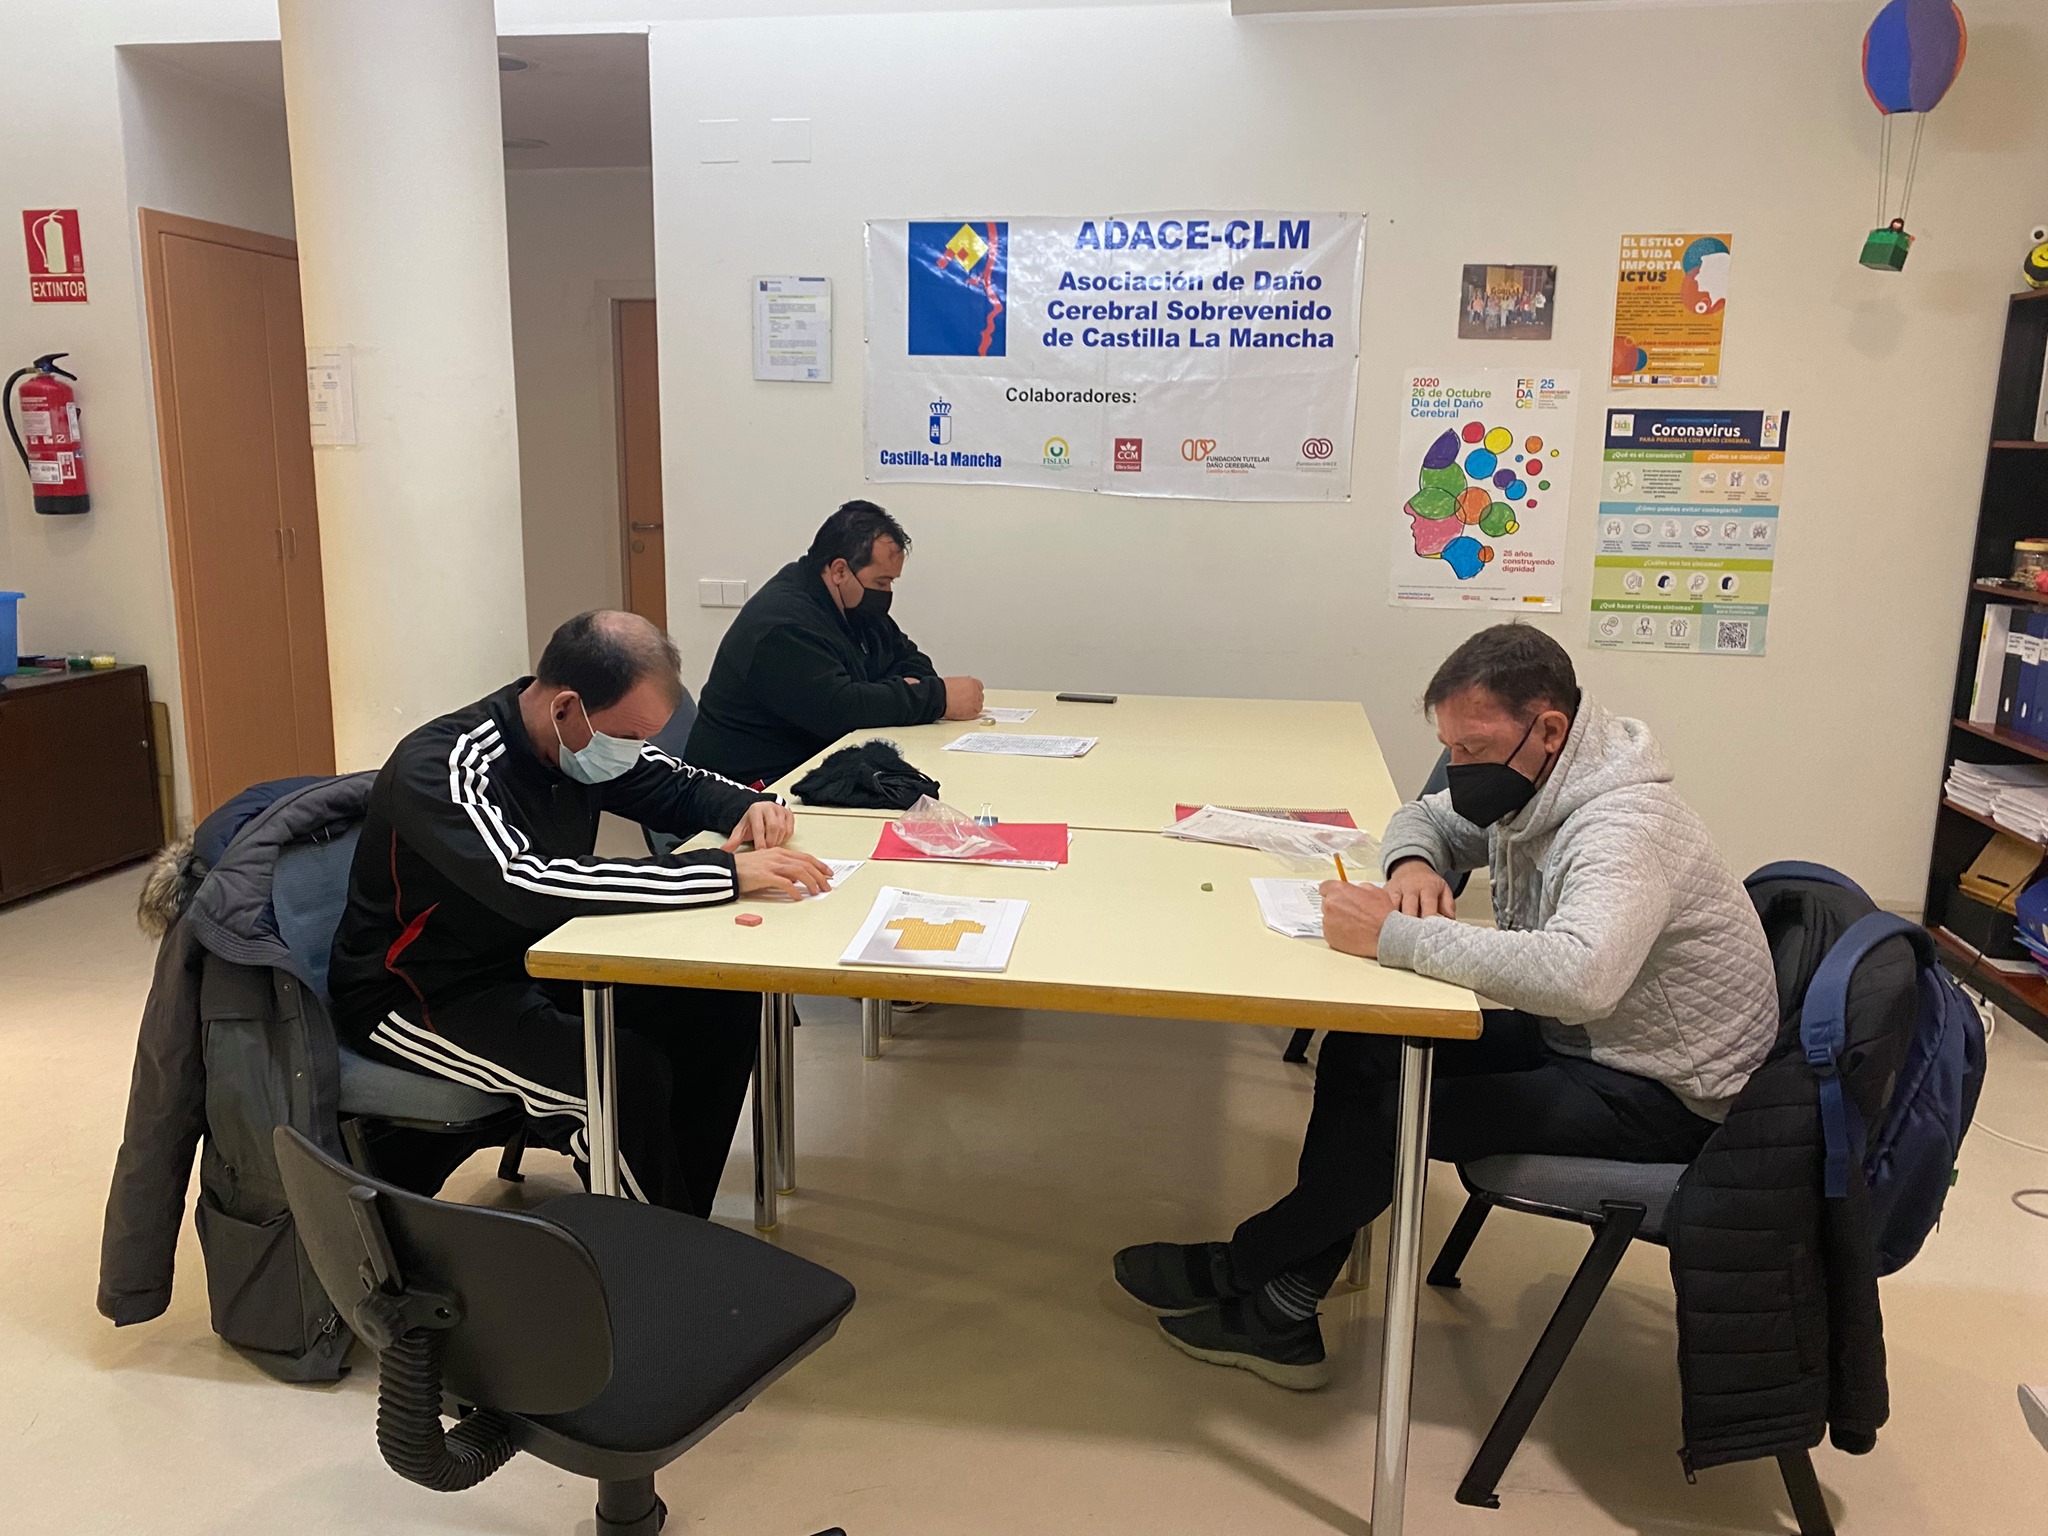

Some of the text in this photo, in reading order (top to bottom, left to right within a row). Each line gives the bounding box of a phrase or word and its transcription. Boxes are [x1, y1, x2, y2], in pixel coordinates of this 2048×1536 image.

[1075, 220, 1311, 250] ADACE-CLM
[1623, 237, 1685, 247] EL ESTILO
[1622, 249, 1672, 259] DE VIDA
[1621, 261, 1682, 270] IMPORTA
[1058, 270, 1322, 291] Asociación de Daño
[1620, 271, 1667, 282] ICTUS
[32, 281, 86, 298] EXTINTOR
[1048, 300, 1332, 321] Cerebral Sobrevenido
[1042, 327, 1334, 348] de Castilla La Mancha
[1412, 378, 1440, 387] 2020
[1540, 379, 1555, 389] 25
[1005, 387, 1137, 404] Colaboradores:
[1412, 388, 1492, 398] 26 de Octubre
[1411, 398, 1484, 409] Día del Daño
[1411, 408, 1459, 418] Cerebral
[1652, 424, 1741, 437] Coronavirus
[880, 450, 1002, 468] Castilla-La Mancha
[1117, 451, 1138, 460] CCM
[1612, 451, 1628, 459] ¿Qué
[1502, 558, 1555, 566] construyendo
[1502, 565, 1535, 573] dignidad
[1600, 602, 1615, 610] ¿Qué
